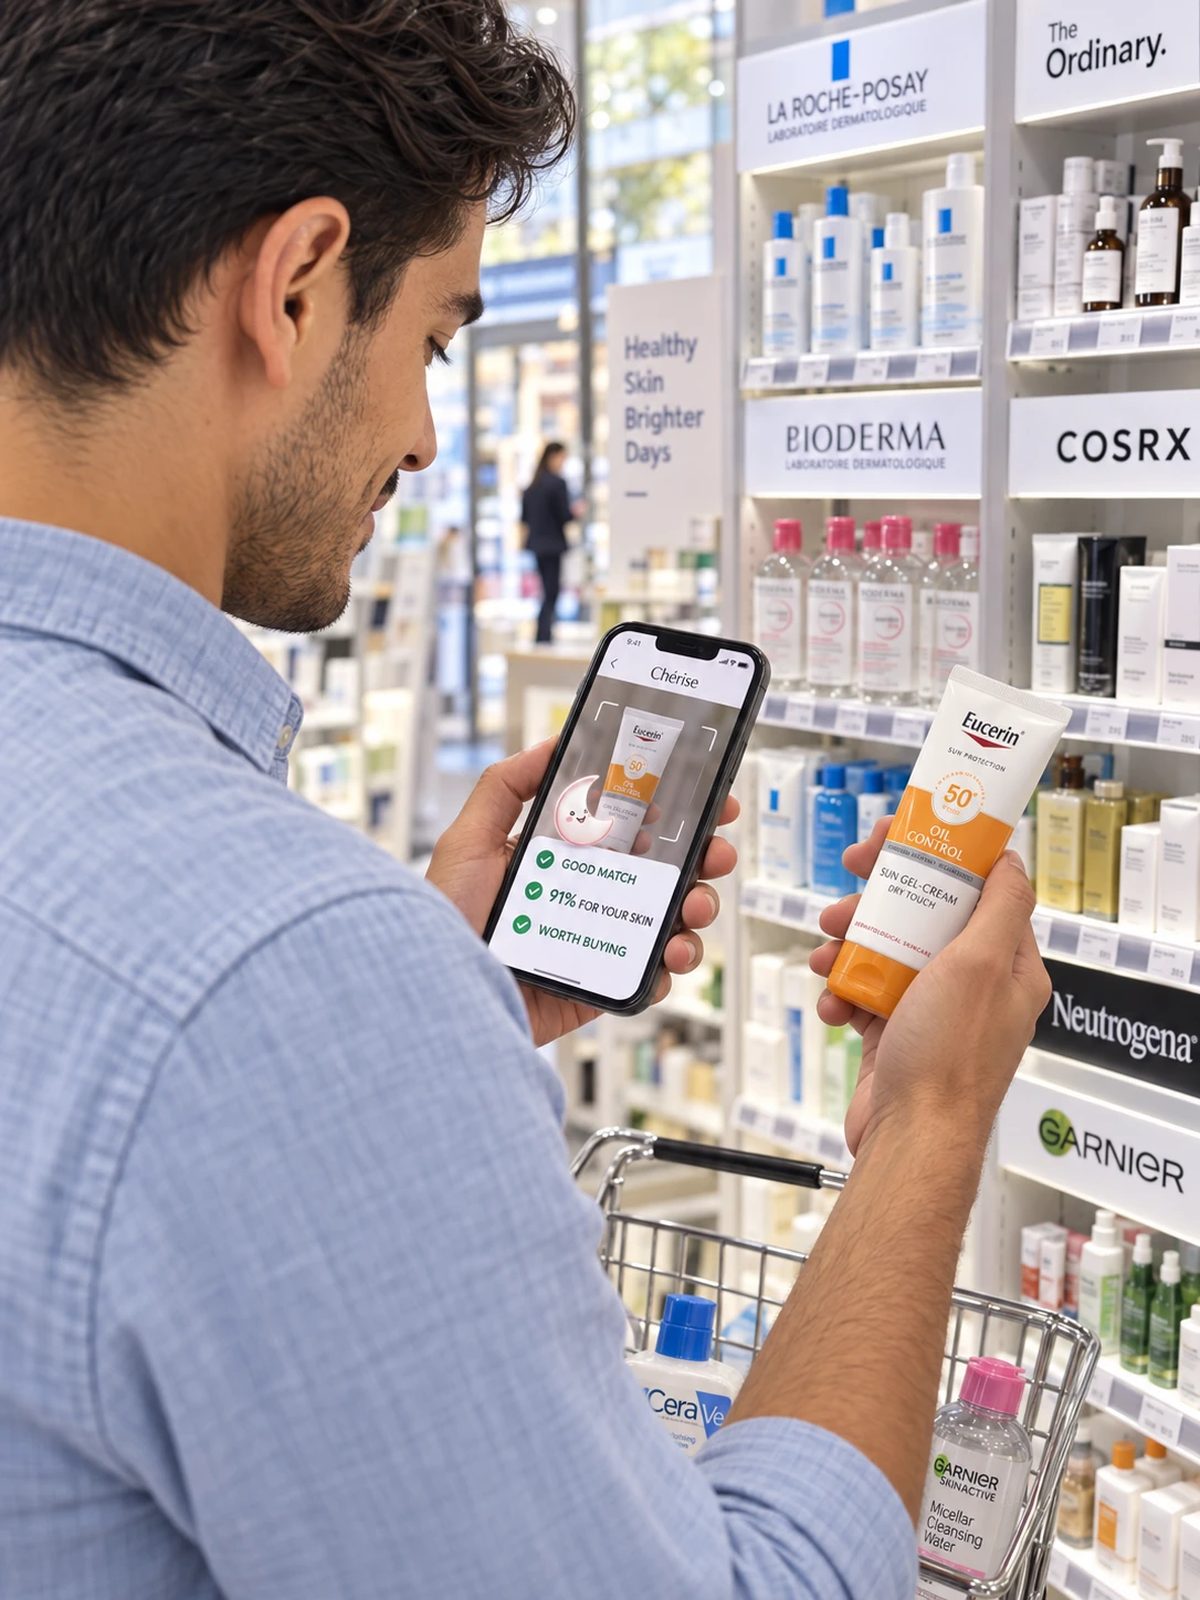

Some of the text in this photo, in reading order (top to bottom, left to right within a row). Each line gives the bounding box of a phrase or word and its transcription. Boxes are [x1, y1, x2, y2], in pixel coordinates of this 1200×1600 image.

[1048, 21, 1078, 43] The
[1046, 33, 1167, 79] Ordinary.
[768, 68, 929, 125] LA ROCHE-POSAY
[767, 100, 927, 144] LABORATOIRE DERMATOLOGIQUE
[624, 331, 698, 363] Healthy
[624, 369, 664, 394] Skin
[625, 405, 704, 435] Brighter
[786, 421, 946, 453] BIODERMA
[1056, 427, 1192, 463] COSRX
[625, 440, 671, 470] Days
[785, 457, 946, 470] LABORATOIRE DERMATOLOGIQUE
[626, 638, 641, 647] 9:41
[650, 666, 699, 689] Chérise
[948, 746, 1006, 772] SUN PROTECTION
[906, 830, 964, 861] CONTROL
[929, 824, 950, 842] OIL
[561, 858, 637, 885] GOOD MATCH
[879, 867, 958, 906] SUN GEL-CREAM
[549, 888, 654, 927] 91% FOR YOUR SKIN
[887, 884, 936, 910] DRY TOUCH
[538, 924, 627, 957] WORTH BUYING
[939, 1475, 996, 1503] SKINACTIVE
[929, 1500, 975, 1527] Micellar
[924, 1530, 956, 1553] Water
[927, 1515, 983, 1550] Cleansing
